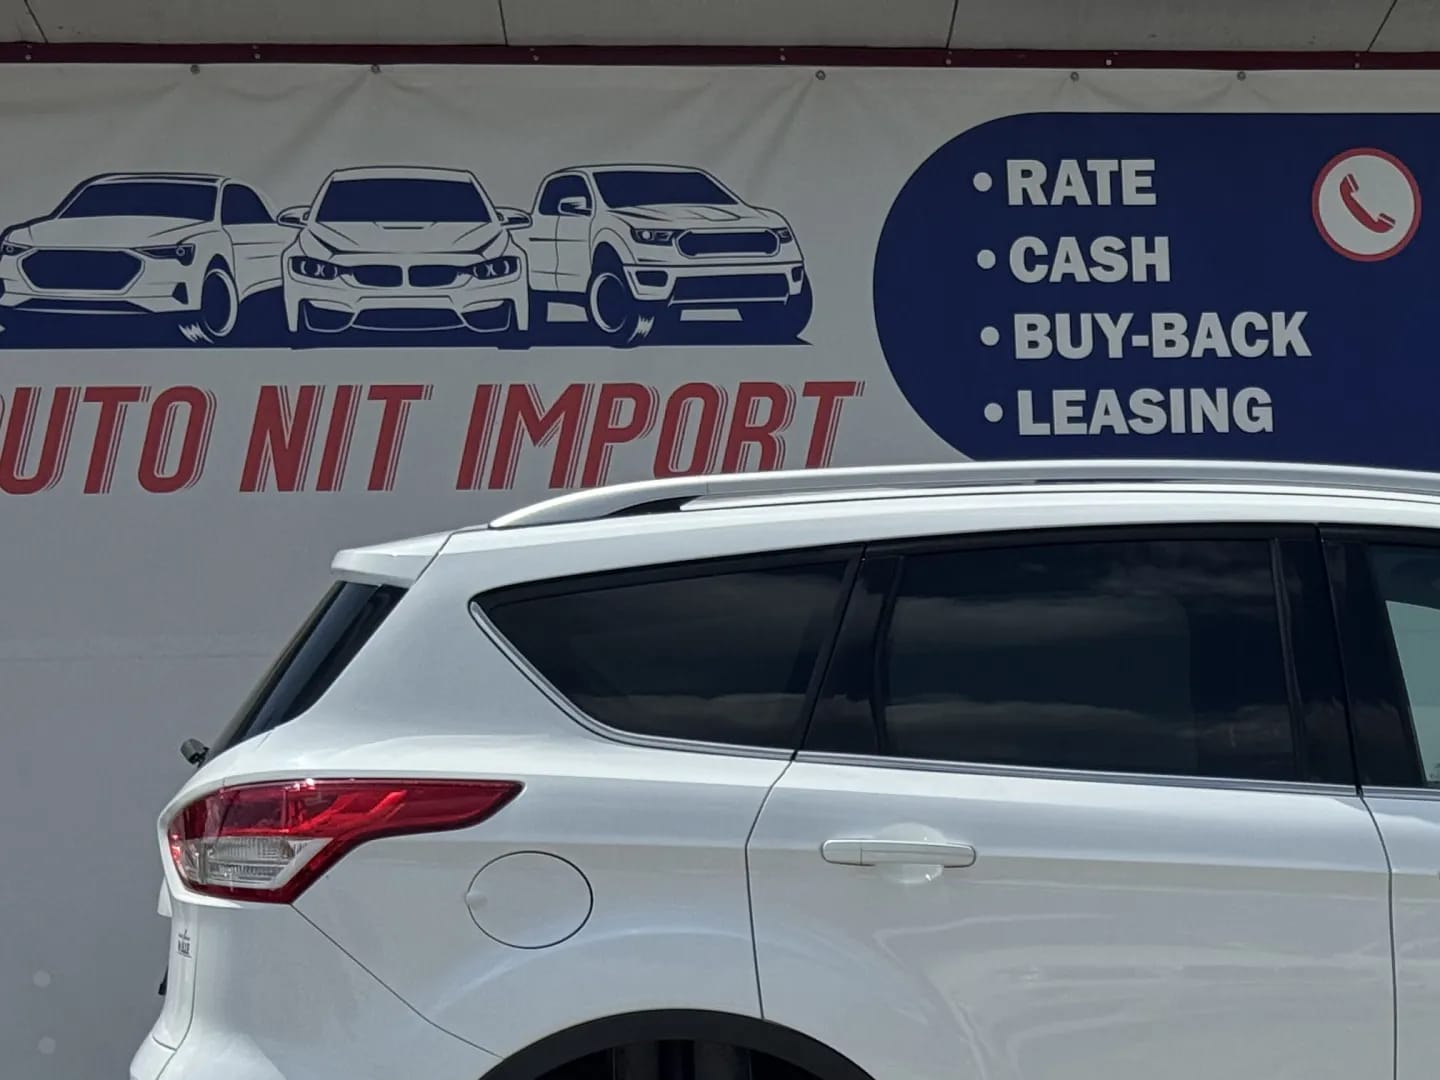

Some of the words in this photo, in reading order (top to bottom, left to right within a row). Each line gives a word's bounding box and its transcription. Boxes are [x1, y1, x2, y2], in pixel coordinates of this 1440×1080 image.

[1006, 159, 1157, 206] RATE
[1009, 236, 1171, 283] CASH
[1014, 311, 1312, 359] BUY-BACK
[1017, 387, 1274, 436] LEASING
[0, 385, 217, 495] UTO
[239, 384, 434, 493] NIT
[456, 381, 866, 490] IMPORT
